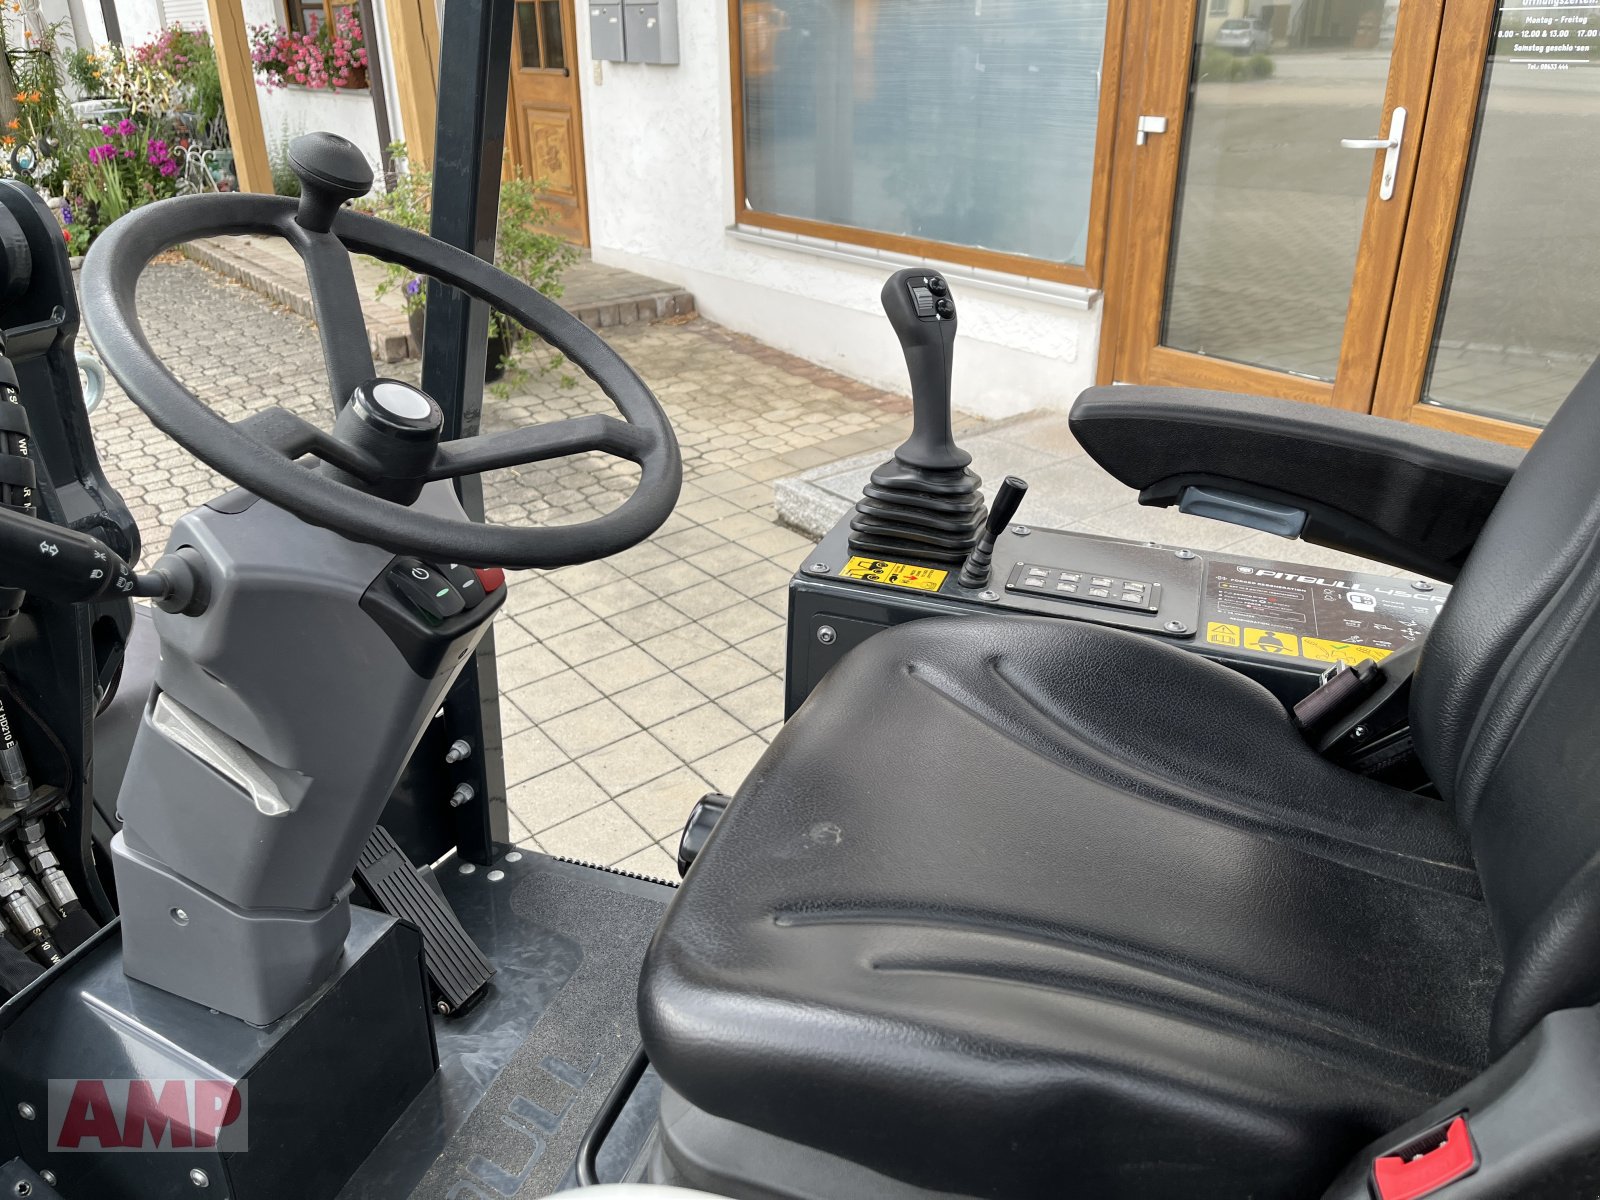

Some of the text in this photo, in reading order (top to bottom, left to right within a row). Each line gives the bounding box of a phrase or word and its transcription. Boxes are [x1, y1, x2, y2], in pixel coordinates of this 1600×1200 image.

[1525, 16, 1553, 25] Montag
[1560, 15, 1588, 24] Freitag
[1521, 29, 1540, 38] 12.00
[1513, 43, 1544, 53] Samstag
[1256, 568, 1367, 592] PITBULL
